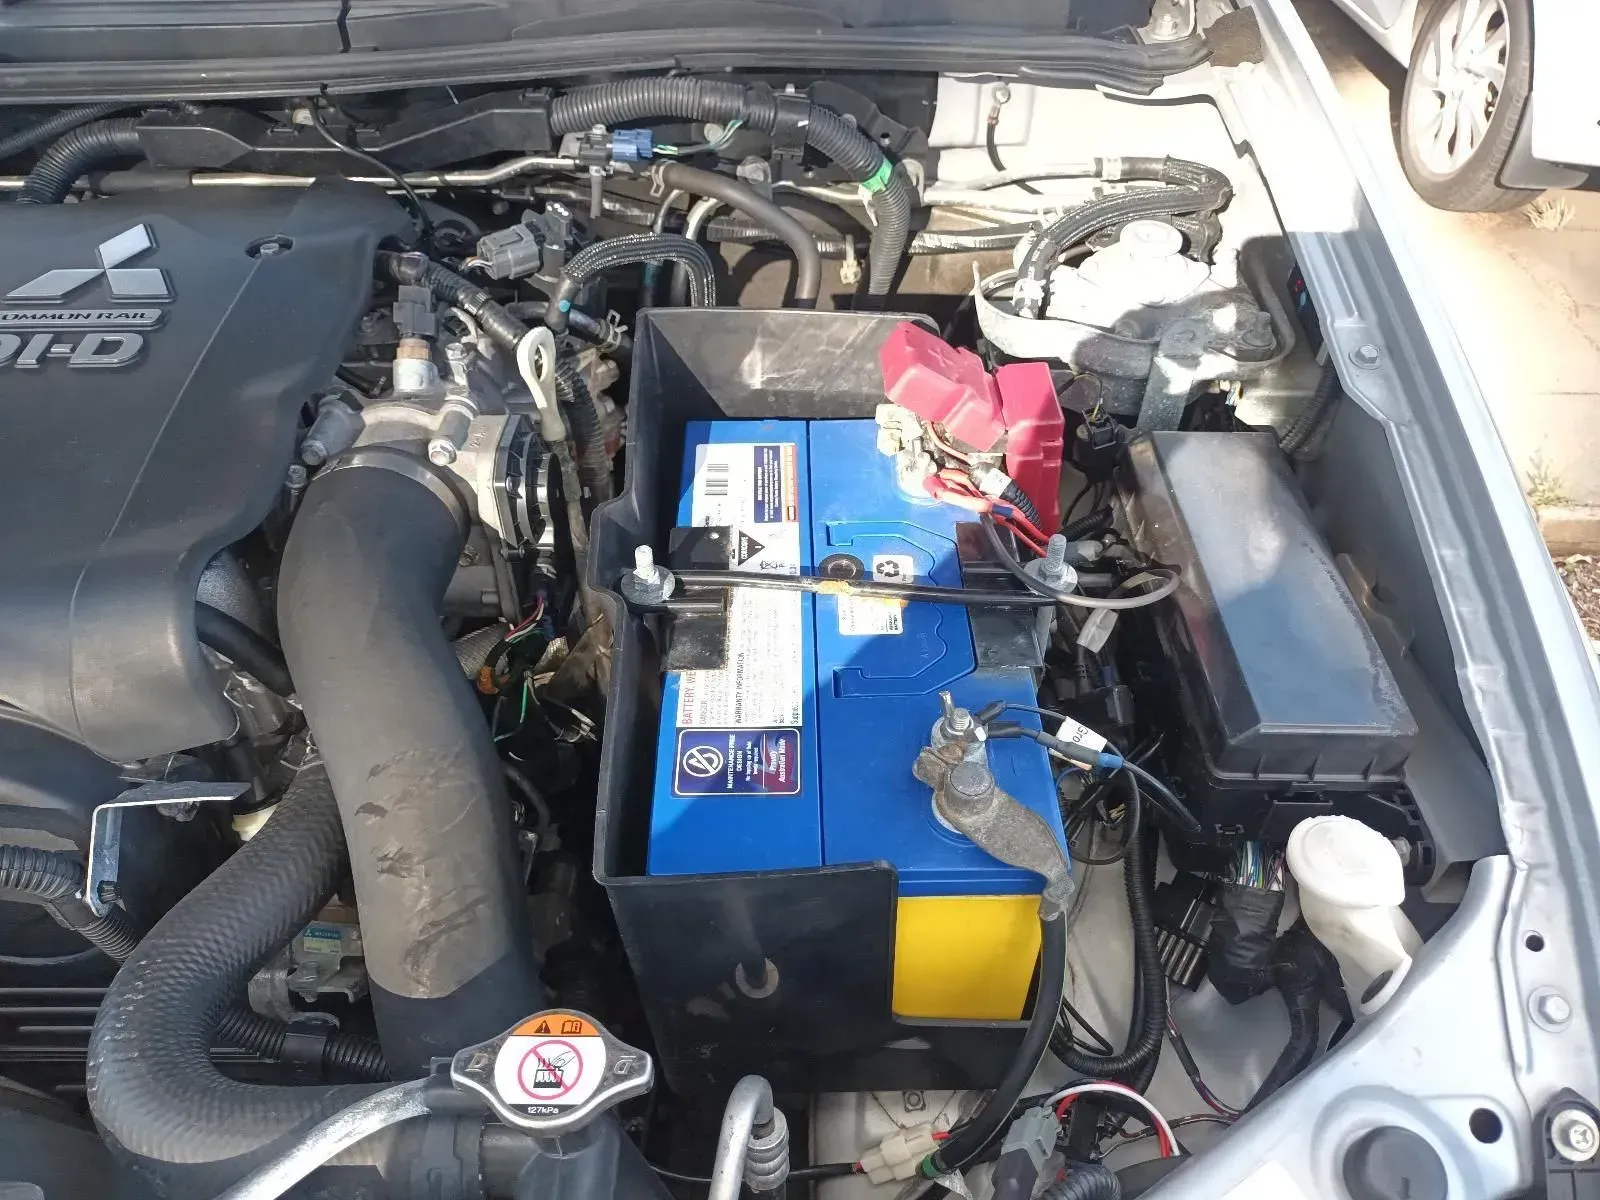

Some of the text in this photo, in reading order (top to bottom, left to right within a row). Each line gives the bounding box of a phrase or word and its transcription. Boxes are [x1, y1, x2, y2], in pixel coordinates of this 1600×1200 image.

[96, 312, 153, 320] RAIL
[735, 652, 744, 724] WARRANTY INFORMATION
[726, 733, 736, 789] MAINTENANCE FREE
[769, 750, 778, 771] Proudly
[778, 738, 786, 783] Australian Made
[528, 1106, 559, 1114] 127kPa
